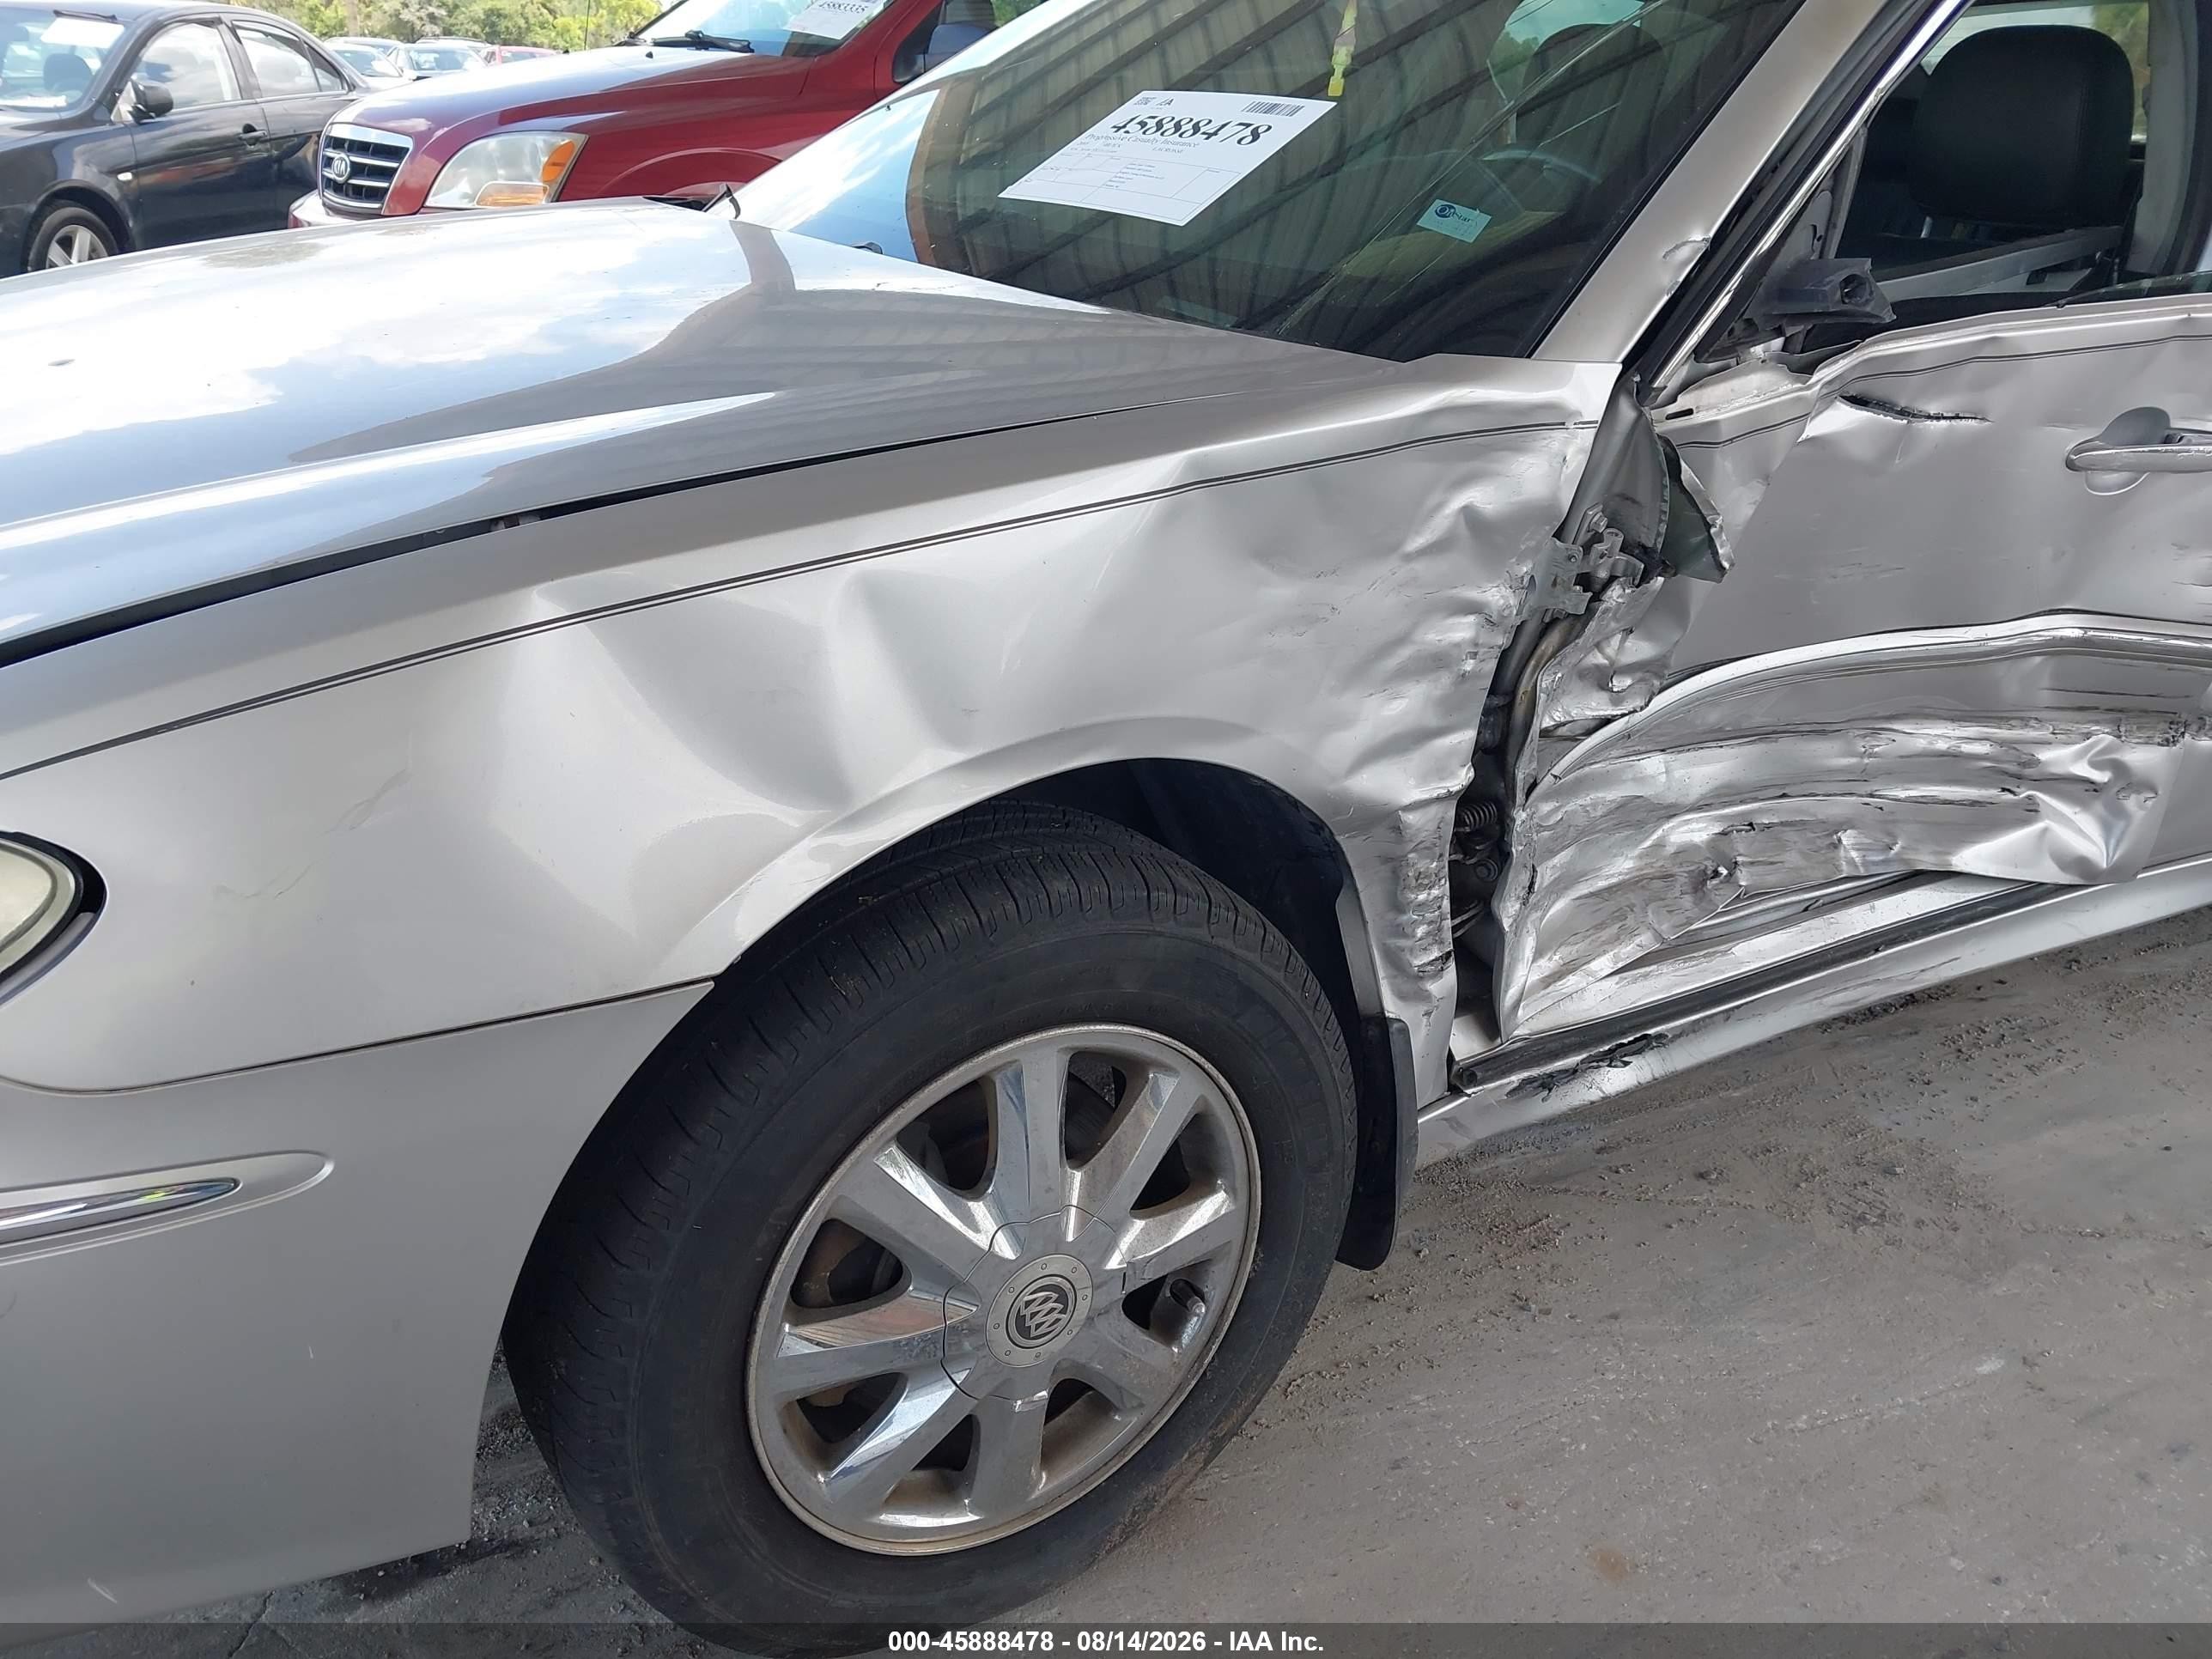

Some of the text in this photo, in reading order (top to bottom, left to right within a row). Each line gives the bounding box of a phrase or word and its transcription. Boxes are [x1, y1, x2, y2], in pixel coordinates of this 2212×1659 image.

[1110, 114, 1273, 145] 45888478
[1127, 135, 1158, 145] Casualty
[1160, 137, 1200, 148] Insurance
[1435, 204, 1472, 222] OnStar
